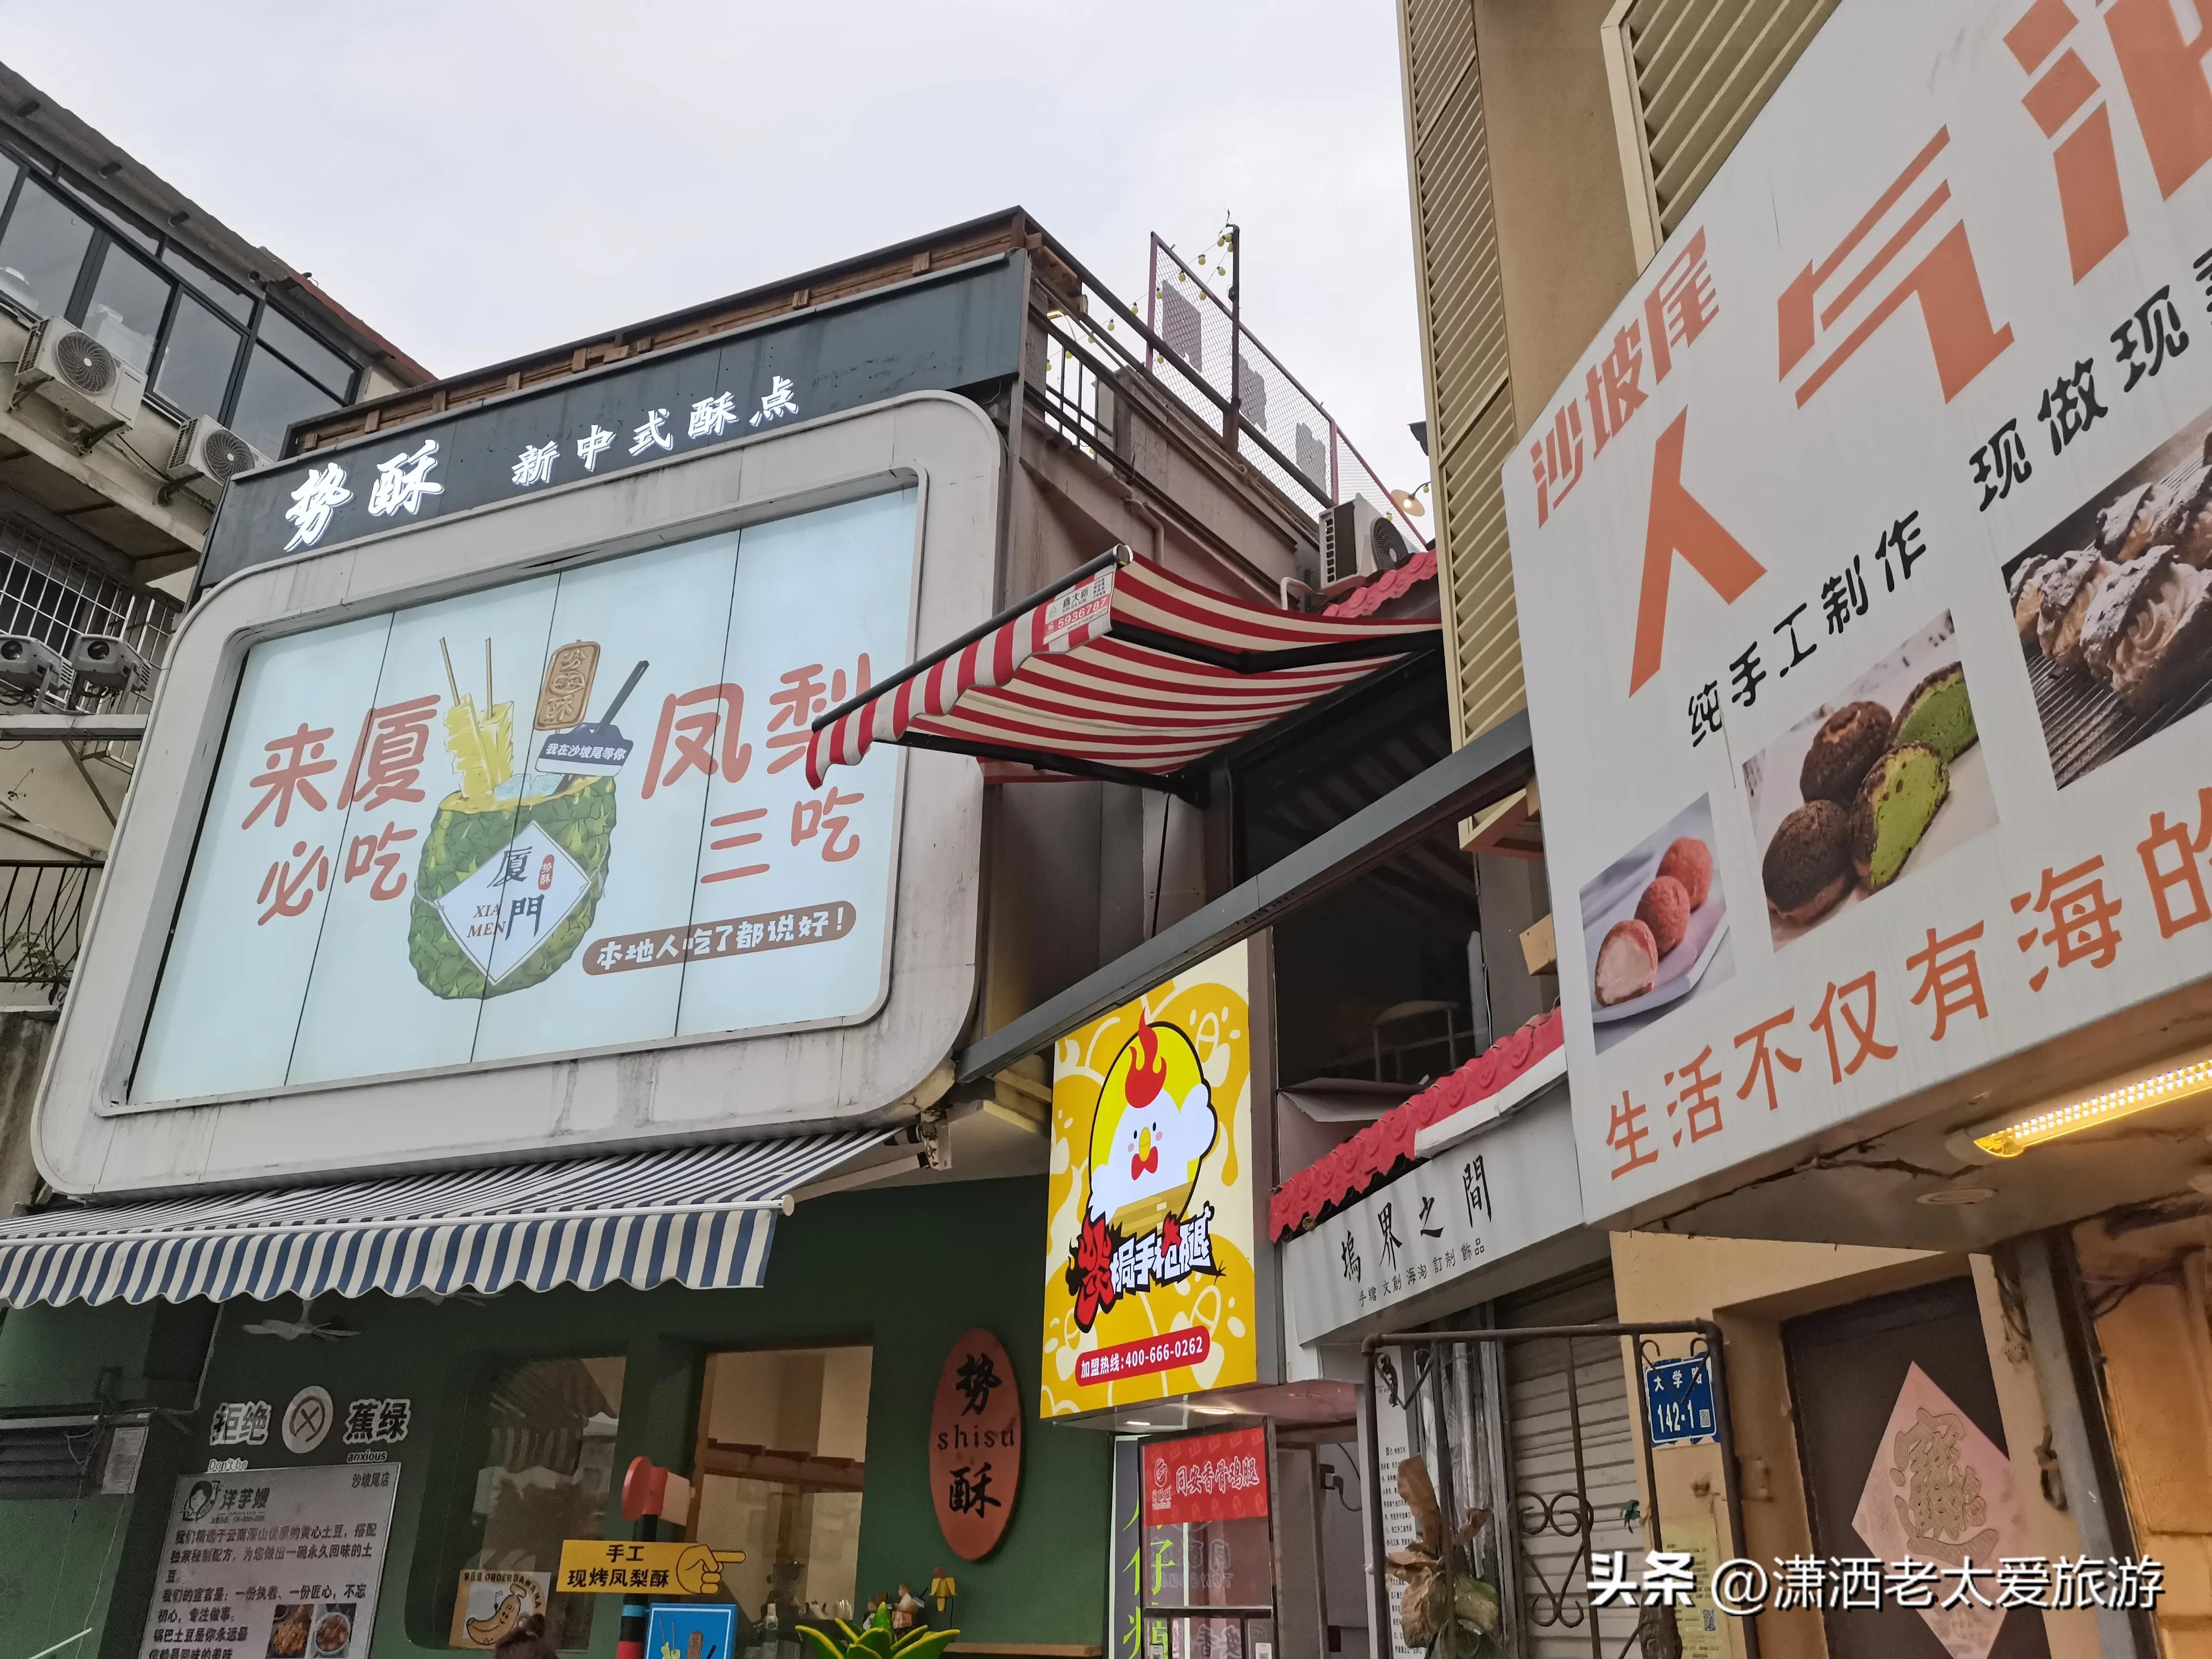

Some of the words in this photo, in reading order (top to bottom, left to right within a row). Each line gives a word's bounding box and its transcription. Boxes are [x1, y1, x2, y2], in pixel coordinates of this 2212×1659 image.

[1530, 224, 1719, 529] 沙坡尾
[284, 439, 445, 552] 势酥
[512, 375, 799, 487] 新中式酥点
[1058, 597, 1107, 629] 5936787
[1687, 510, 1926, 747] 纯手工制作
[241, 695, 441, 830] 来厦
[546, 743, 627, 761] 我在沙坡尾等你
[700, 786, 865, 884] 三吃
[257, 821, 418, 926] 必吃
[473, 903, 500, 918] XIA
[467, 921, 507, 938] MEN
[596, 907, 844, 970] 本地人吃了都说好！
[1606, 787, 2212, 1180] 生活不仅有海的
[1654, 1366, 1702, 1392] 大学路
[211, 1403, 271, 1443] 拒绝
[345, 1400, 409, 1442] 蕉绿
[937, 1423, 1015, 1450] shisu
[209, 1460, 233, 1471] Don't
[235, 1458, 248, 1469] be
[348, 1450, 387, 1463] anxious
[606, 1544, 645, 1563] 手工
[567, 1568, 670, 1588] 现烤凤梨酥
